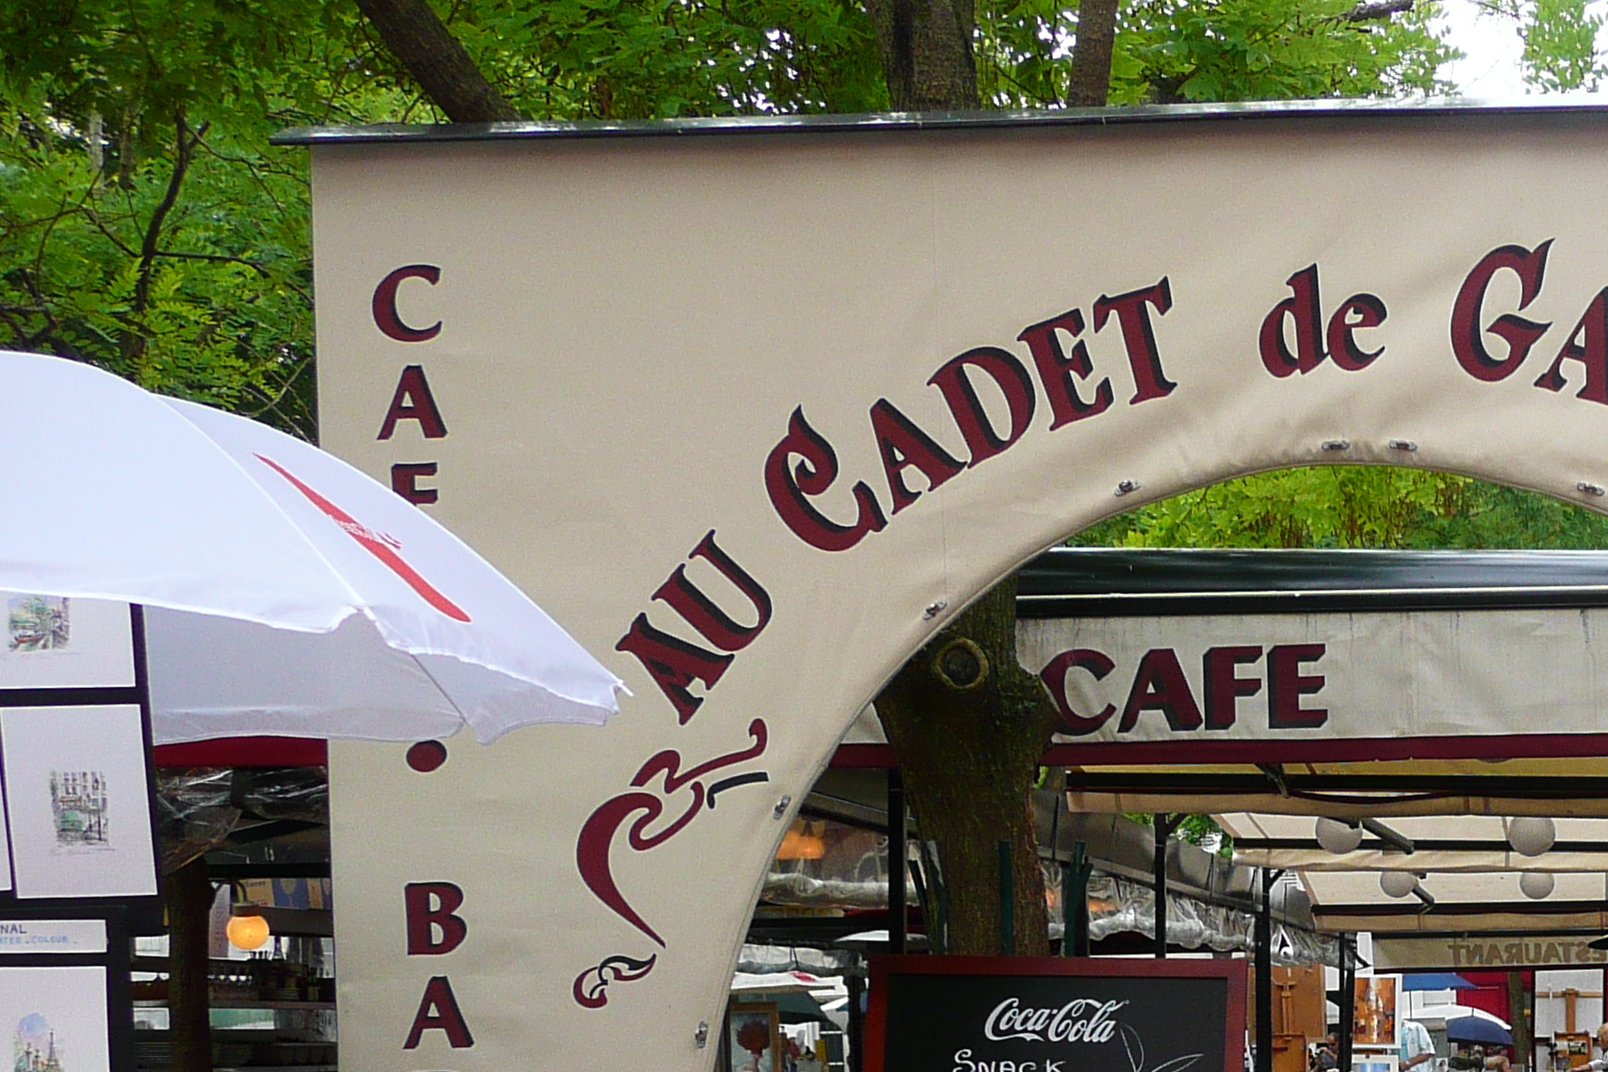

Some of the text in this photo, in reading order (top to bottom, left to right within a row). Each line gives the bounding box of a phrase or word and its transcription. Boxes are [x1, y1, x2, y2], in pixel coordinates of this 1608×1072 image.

[372, 264, 447, 504] CAF
[614, 529, 773, 725] AU
[764, 275, 1178, 552] CADET
[1257, 262, 1388, 379] de
[1040, 643, 1329, 736] CAFE
[985, 998, 1129, 1043] Coca-Cola
